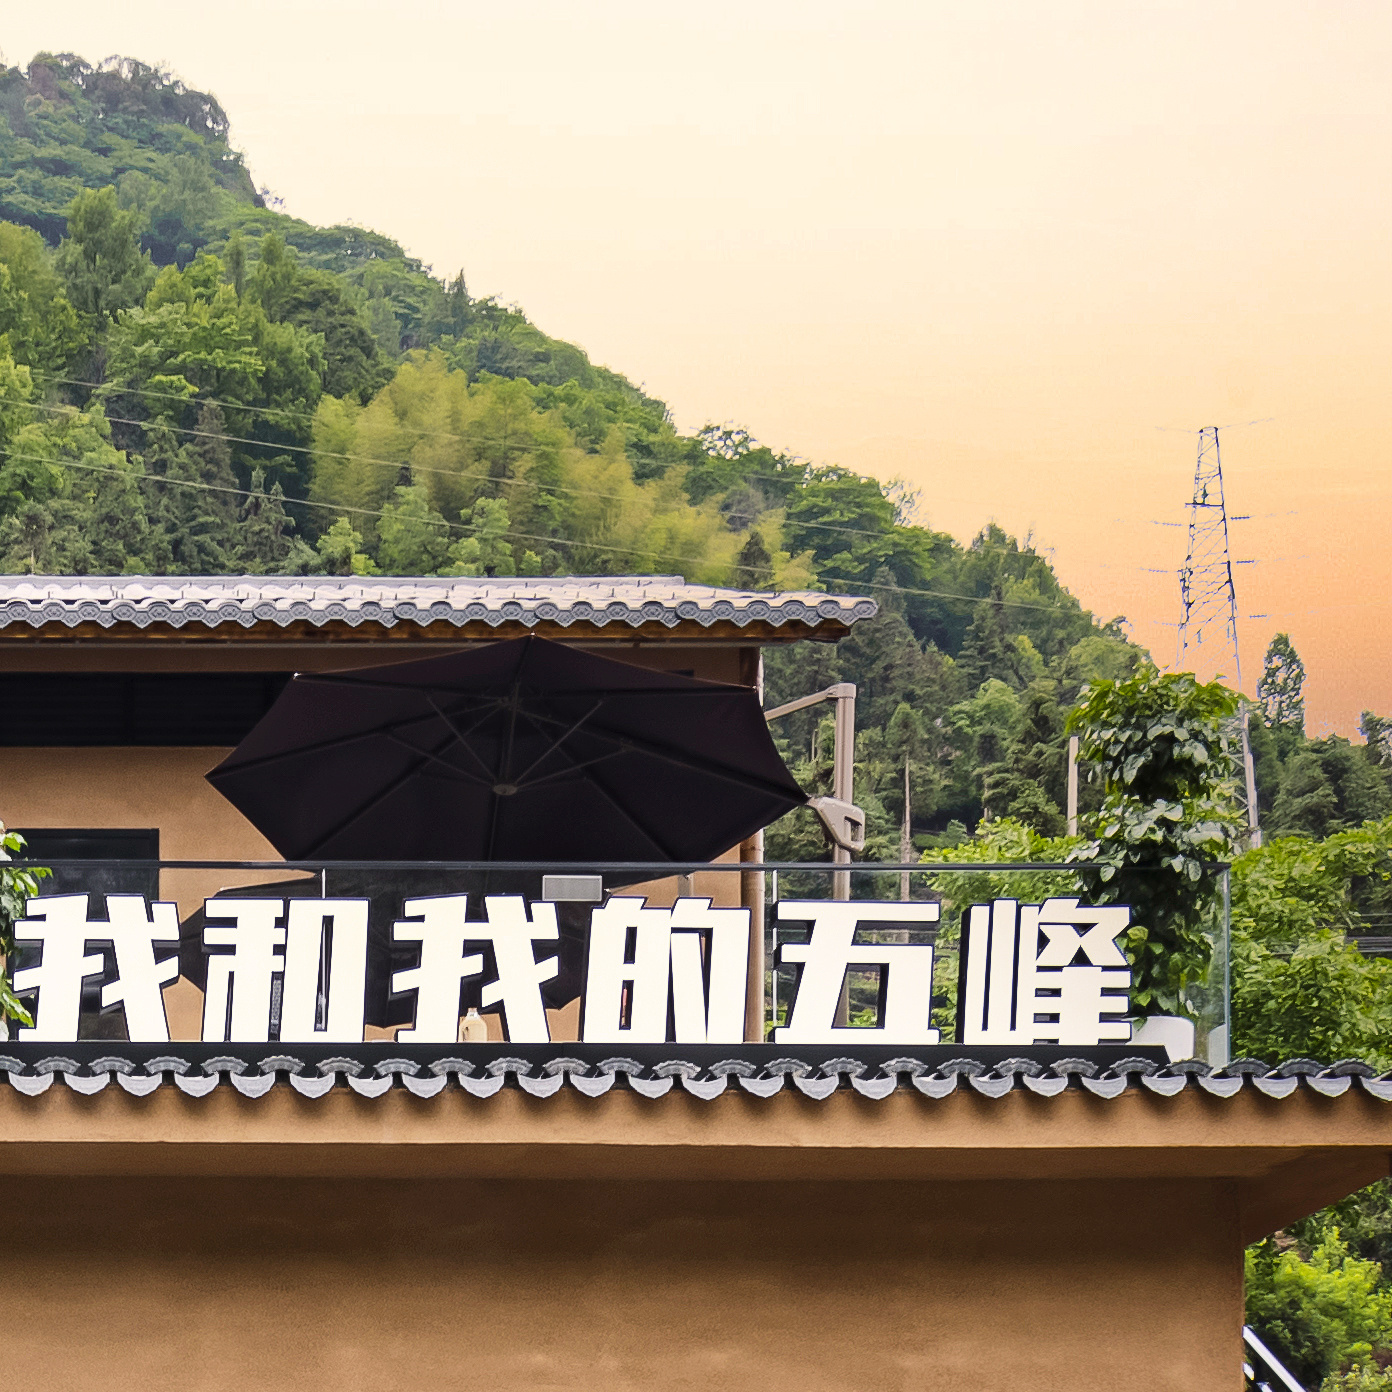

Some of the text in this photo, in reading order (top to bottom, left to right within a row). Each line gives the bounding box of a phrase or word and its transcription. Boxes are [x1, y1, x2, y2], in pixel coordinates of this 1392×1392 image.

[13, 892, 1132, 1045] 我和我的五峰
